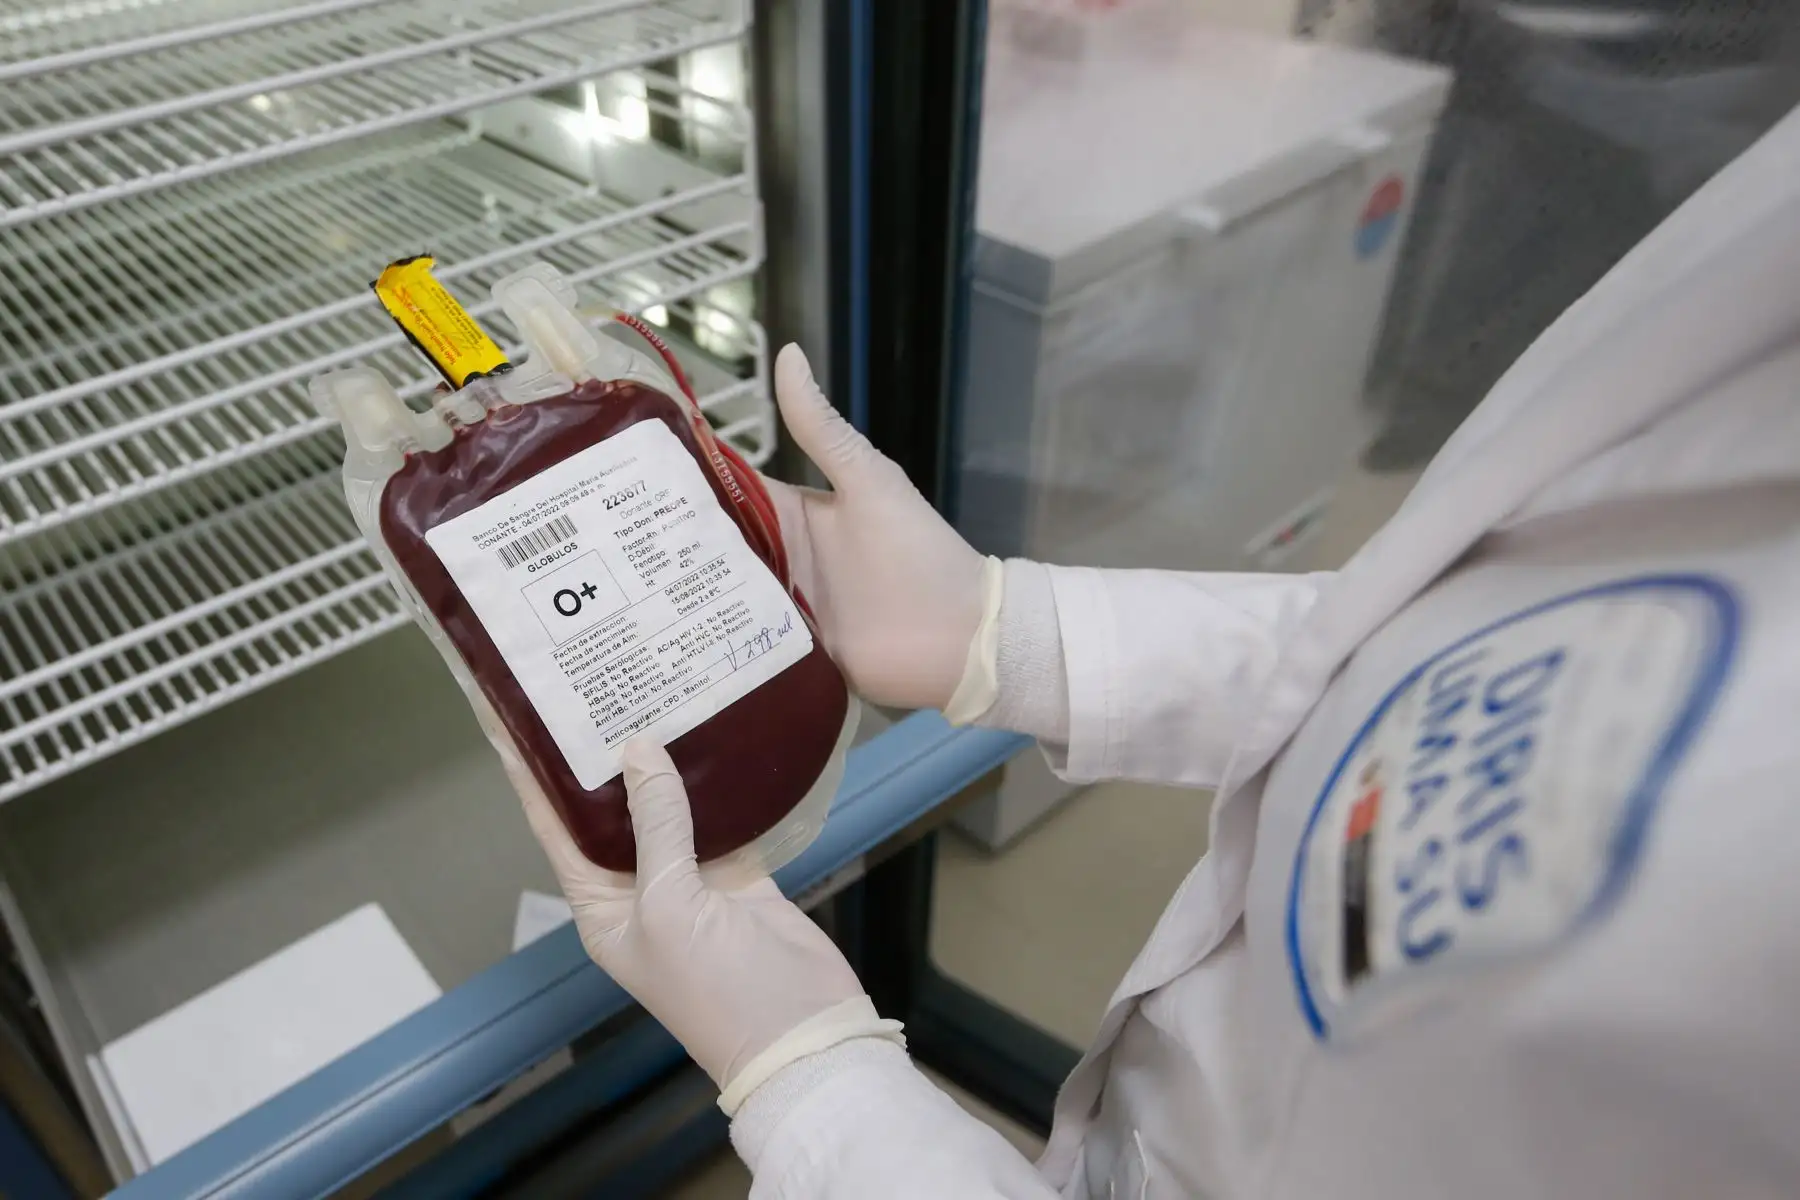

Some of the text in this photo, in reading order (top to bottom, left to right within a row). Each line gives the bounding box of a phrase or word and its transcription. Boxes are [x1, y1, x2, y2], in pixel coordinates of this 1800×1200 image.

[472, 527, 498, 542] Banco
[497, 521, 509, 529] De
[509, 508, 536, 524] Sangre
[535, 499, 549, 510] Del
[549, 484, 579, 503] Hospital
[613, 526, 634, 539] Tipo
[633, 515, 654, 529] Don:
[478, 525, 518, 550] DONANTE
[677, 546, 692, 558] 250
[527, 542, 578, 573] GLOBULOS
[679, 558, 694, 569] 42%
[553, 582, 598, 617] O+
[664, 573, 700, 596] 04/07/2022
[671, 582, 706, 605] 15/08/2022
[677, 600, 699, 616] Desde
[657, 638, 681, 655] AC/Ag
[679, 629, 691, 641] HIV
[706, 616, 717, 624] No
[715, 600, 744, 619] Reactivo
[680, 639, 695, 653] Anti
[711, 624, 722, 633] No
[553, 644, 578, 661] Fecha
[578, 638, 588, 647] de
[559, 653, 584, 670] Fecha
[583, 647, 594, 656] de
[671, 656, 687, 670] Anti
[686, 643, 705, 660] HTLV
[715, 633, 726, 642] No
[725, 617, 753, 636] Reactivo
[564, 648, 612, 677] Temperatura
[612, 642, 622, 651] de
[573, 671, 605, 693] Pruebas
[583, 655, 653, 699] SIFILIS: No Reactivo
[588, 663, 660, 708] HBsAg: No Reactivo
[620, 691, 633, 700] No
[632, 671, 664, 693] Reactivo
[595, 713, 612, 728] Anti
[611, 705, 629, 718] HBc
[650, 685, 662, 694] No
[661, 666, 693, 687] Reactivo
[605, 706, 663, 745] Anticoagulante:
[663, 694, 679, 708] CPD
[1457, 647, 1566, 911] DIRIS
[1396, 838, 1454, 964] SU
